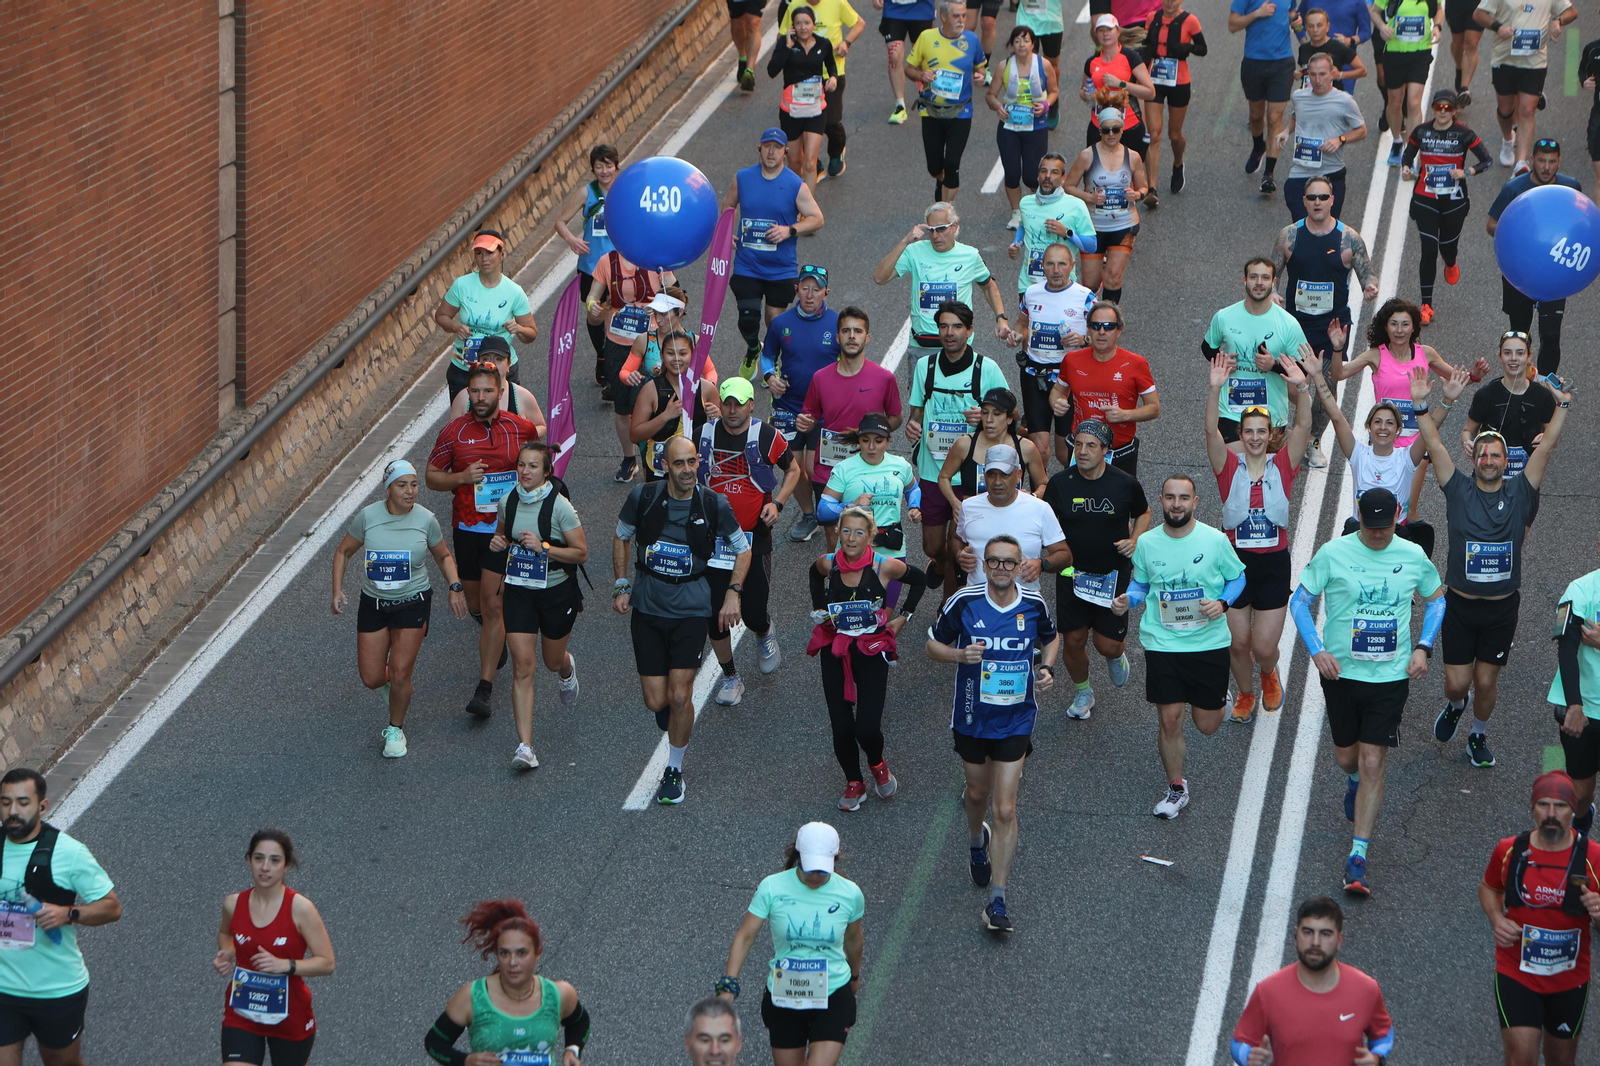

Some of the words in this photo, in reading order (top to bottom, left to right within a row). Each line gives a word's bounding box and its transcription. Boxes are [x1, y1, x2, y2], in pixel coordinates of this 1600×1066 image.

[640, 186, 682, 212] 4:30
[1549, 237, 1591, 272] 4:30
[490, 474, 512, 482] ZURICH
[724, 484, 742, 494] ALEX
[1072, 498, 1114, 512] FILA
[663, 546, 687, 554] ZURICH
[517, 562, 534, 570] 11354
[1086, 580, 1102, 588] 11322
[1096, 590, 1111, 598] RAPAZ
[1173, 591, 1198, 599] ZURICH
[1356, 608, 1396, 617] SEVILLA'24
[971, 636, 1030, 650] DIGI
[1543, 932, 1573, 941] ZURICH
[251, 975, 280, 986] ZURICH
[248, 992, 269, 1002] 12827
[248, 1003, 268, 1012] ITZIAR
[511, 1054, 542, 1063] ZURICH
